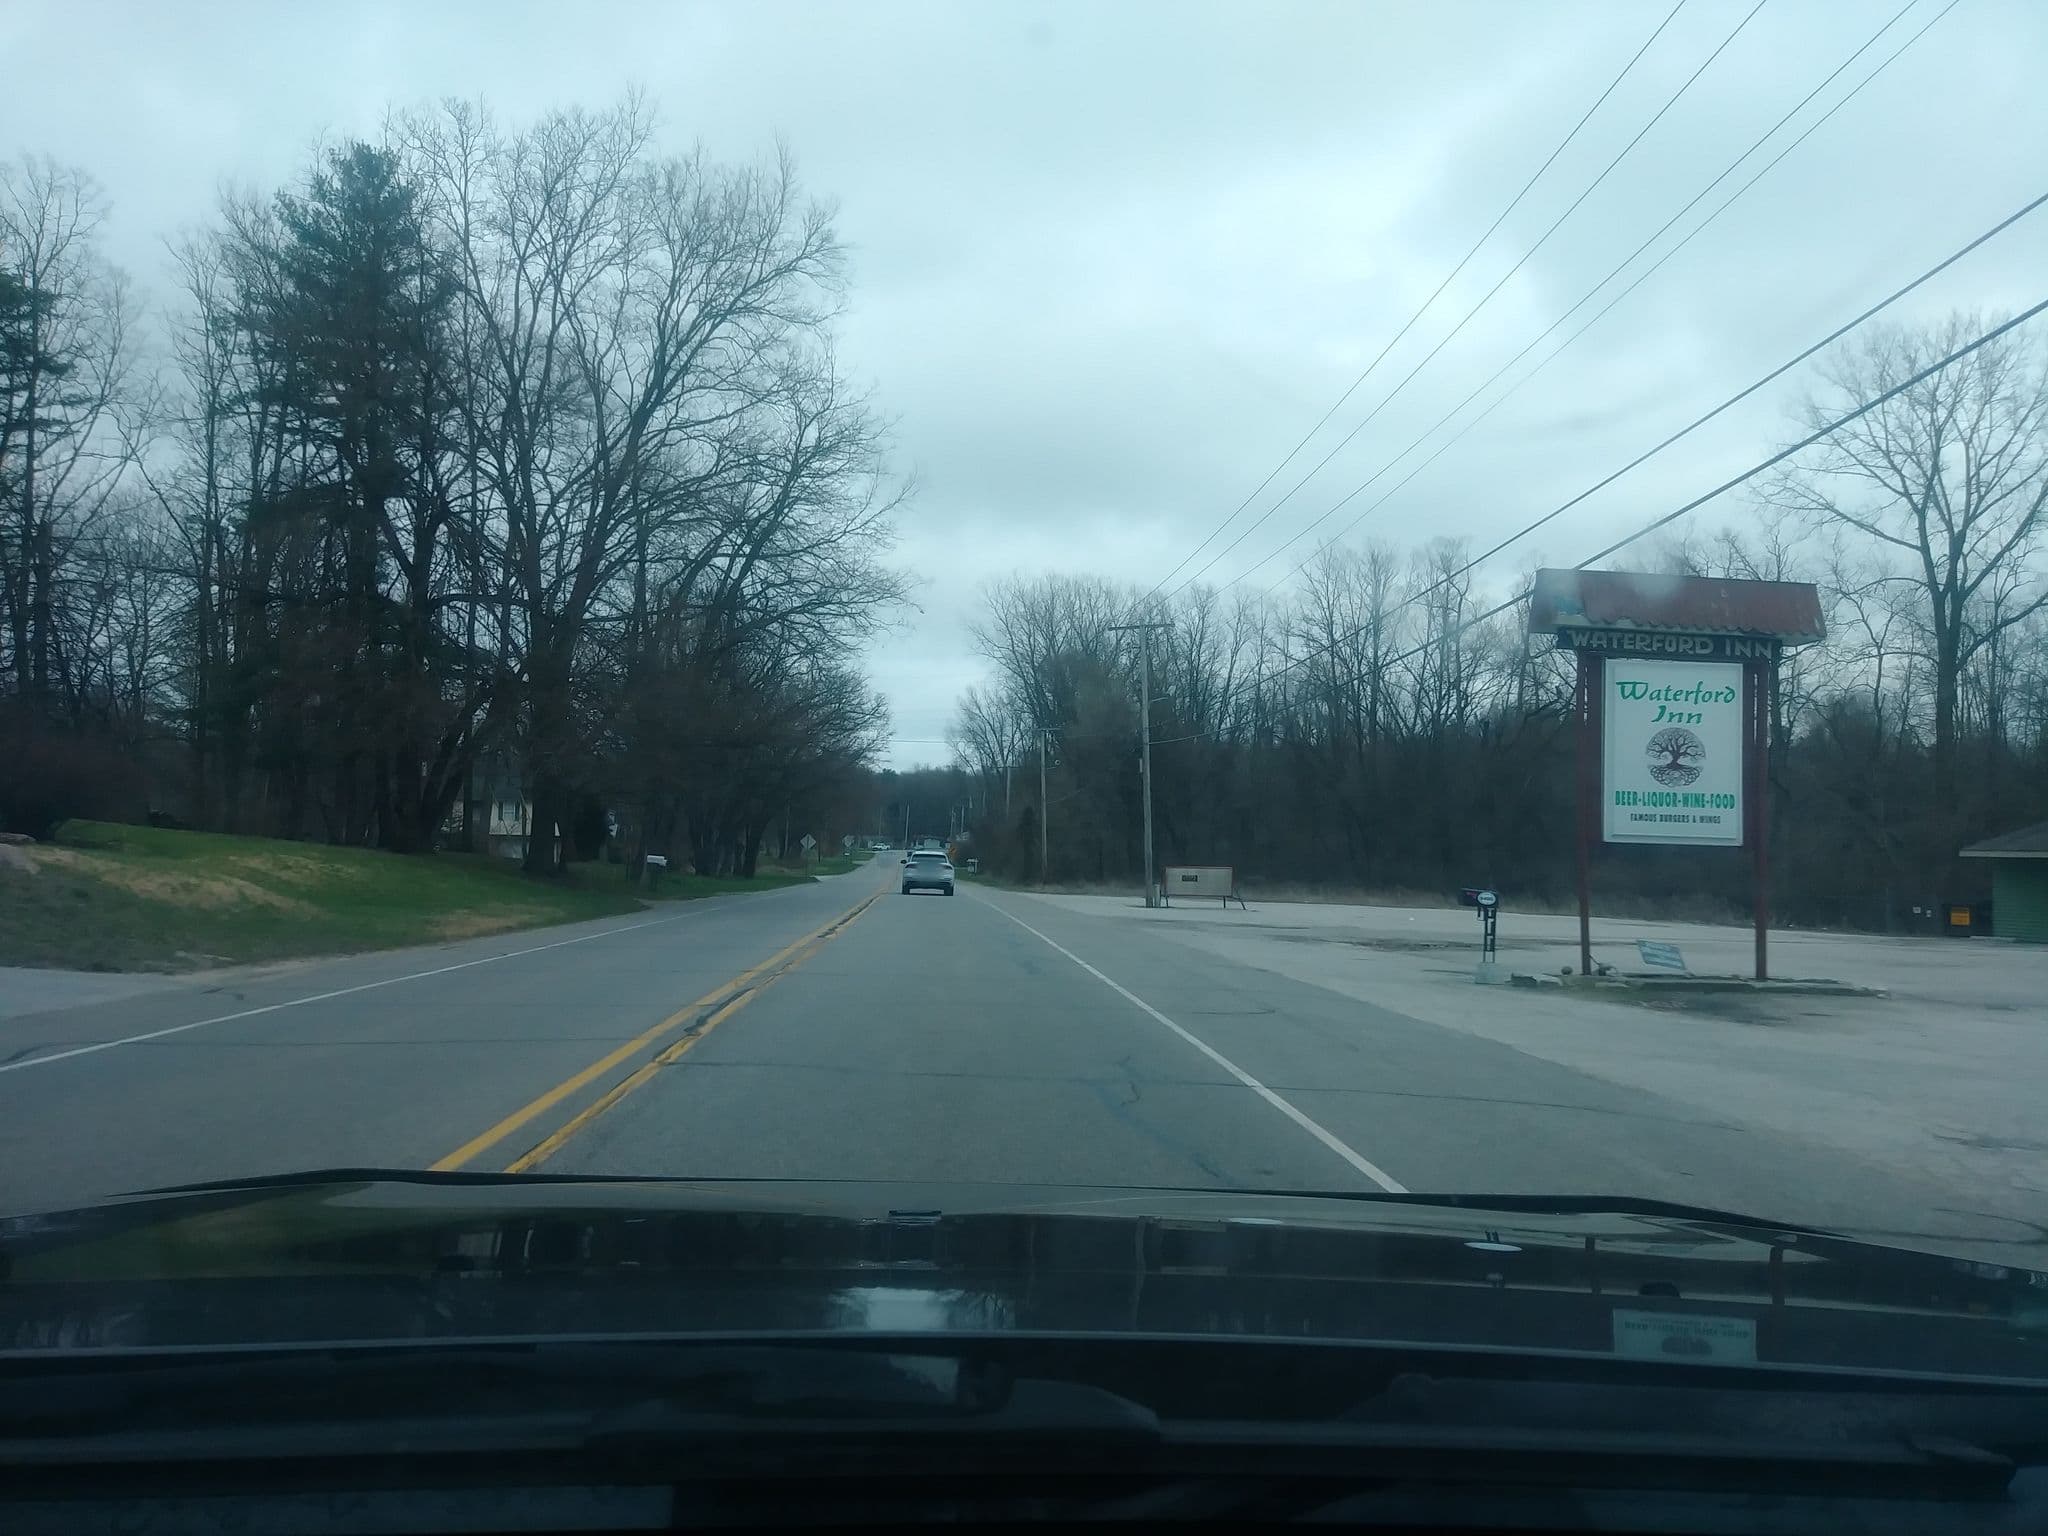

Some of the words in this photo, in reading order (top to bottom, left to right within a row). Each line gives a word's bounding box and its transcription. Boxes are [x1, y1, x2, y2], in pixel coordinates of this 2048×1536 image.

[1568, 630, 1714, 654] WATERFORD
[1725, 638, 1773, 658] INN
[1616, 681, 1736, 705] Waterford
[1651, 705, 1702, 724] Inn
[1630, 813, 1657, 823] FAMOUS
[1659, 814, 1690, 823] BURGERS
[1699, 815, 1721, 824] WINGS
